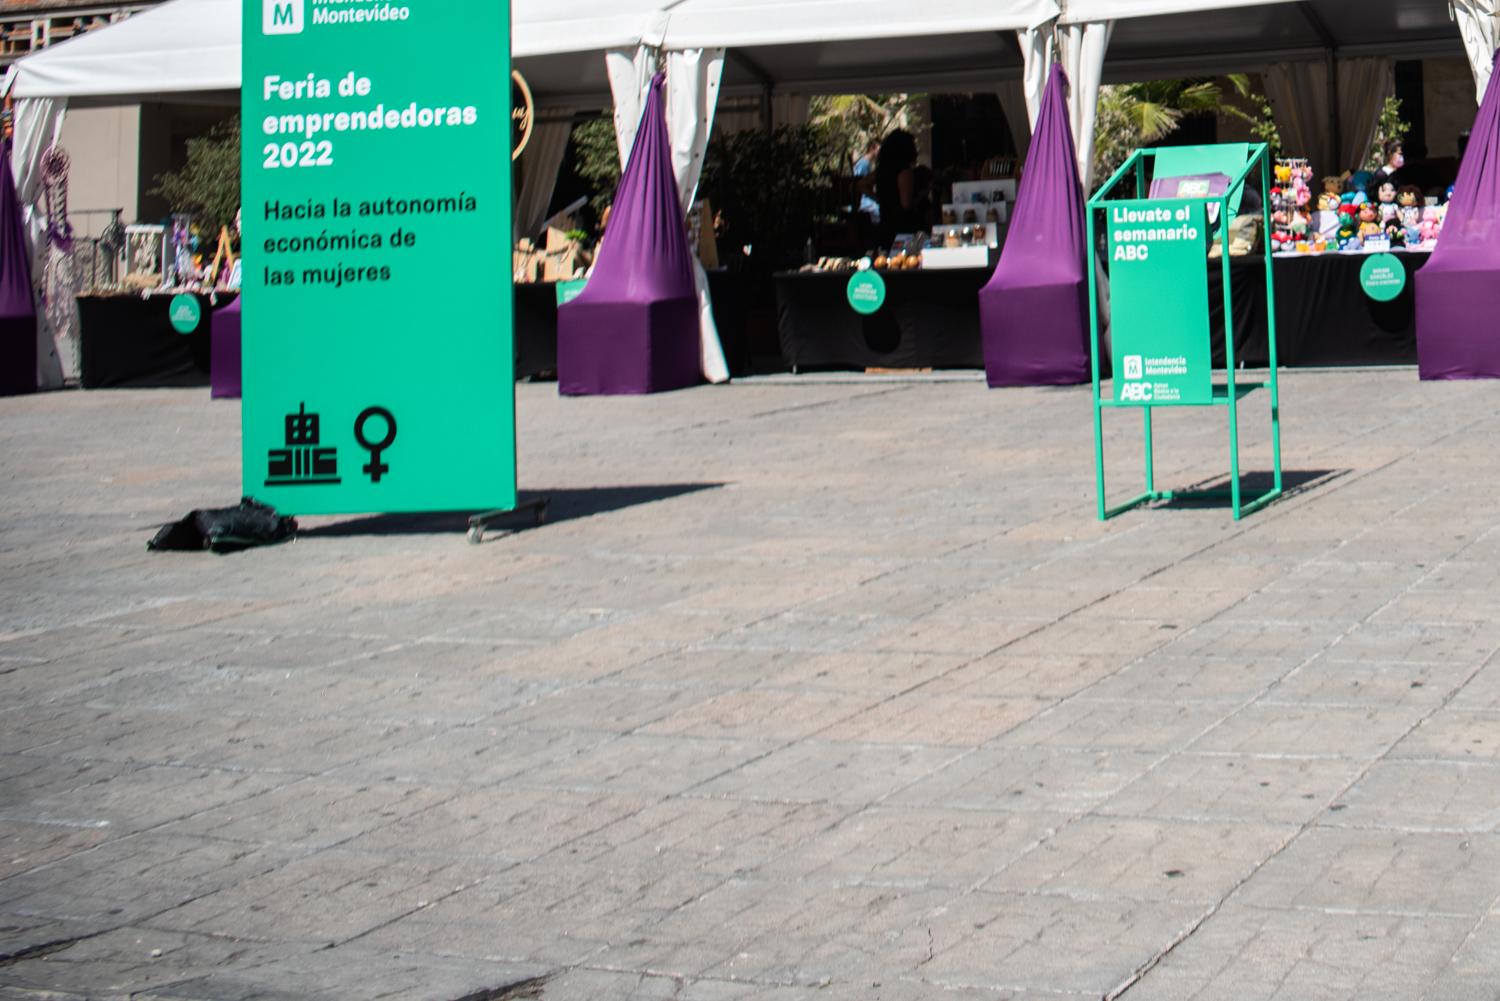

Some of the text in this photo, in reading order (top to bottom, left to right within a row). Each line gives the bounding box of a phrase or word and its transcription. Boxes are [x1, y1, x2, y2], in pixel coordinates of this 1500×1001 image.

[312, 4, 410, 25] Montevideo
[263, 72, 371, 101] Feria de
[263, 102, 478, 138] emprendedoras
[262, 141, 333, 169] 2022
[1179, 182, 1207, 195] ABC
[264, 191, 477, 221] Hacia la autonomía
[1113, 204, 1190, 224] Llevate el
[263, 228, 416, 253] económica de
[1113, 223, 1198, 242] semanario
[1113, 245, 1149, 261] ABC
[264, 262, 391, 288] las mujeres
[1144, 356, 1187, 366] Intendencia
[1145, 365, 1188, 375] Montevideo
[1120, 382, 1153, 401] ABC
